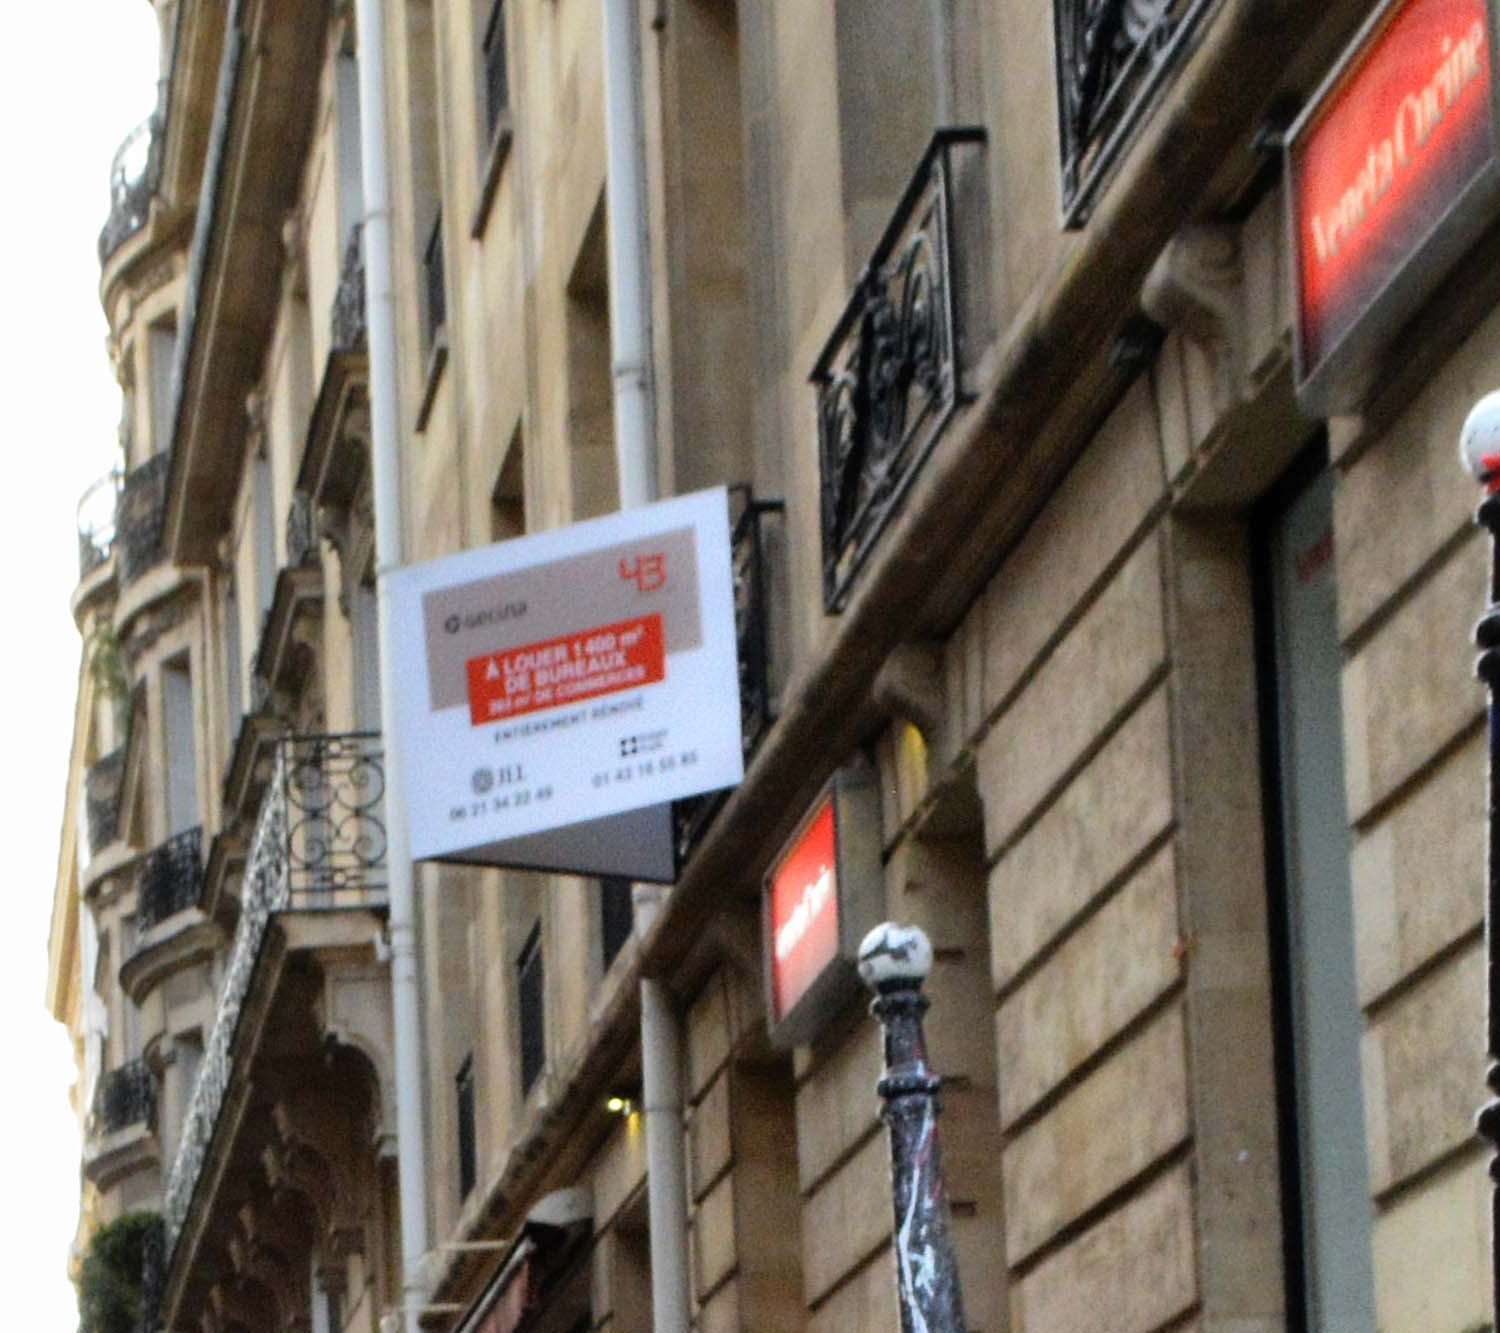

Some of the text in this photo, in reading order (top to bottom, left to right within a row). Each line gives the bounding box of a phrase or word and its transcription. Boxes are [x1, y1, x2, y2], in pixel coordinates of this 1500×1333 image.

[503, 644, 568, 675] LOUER
[505, 651, 626, 694] DE BUREAUX
